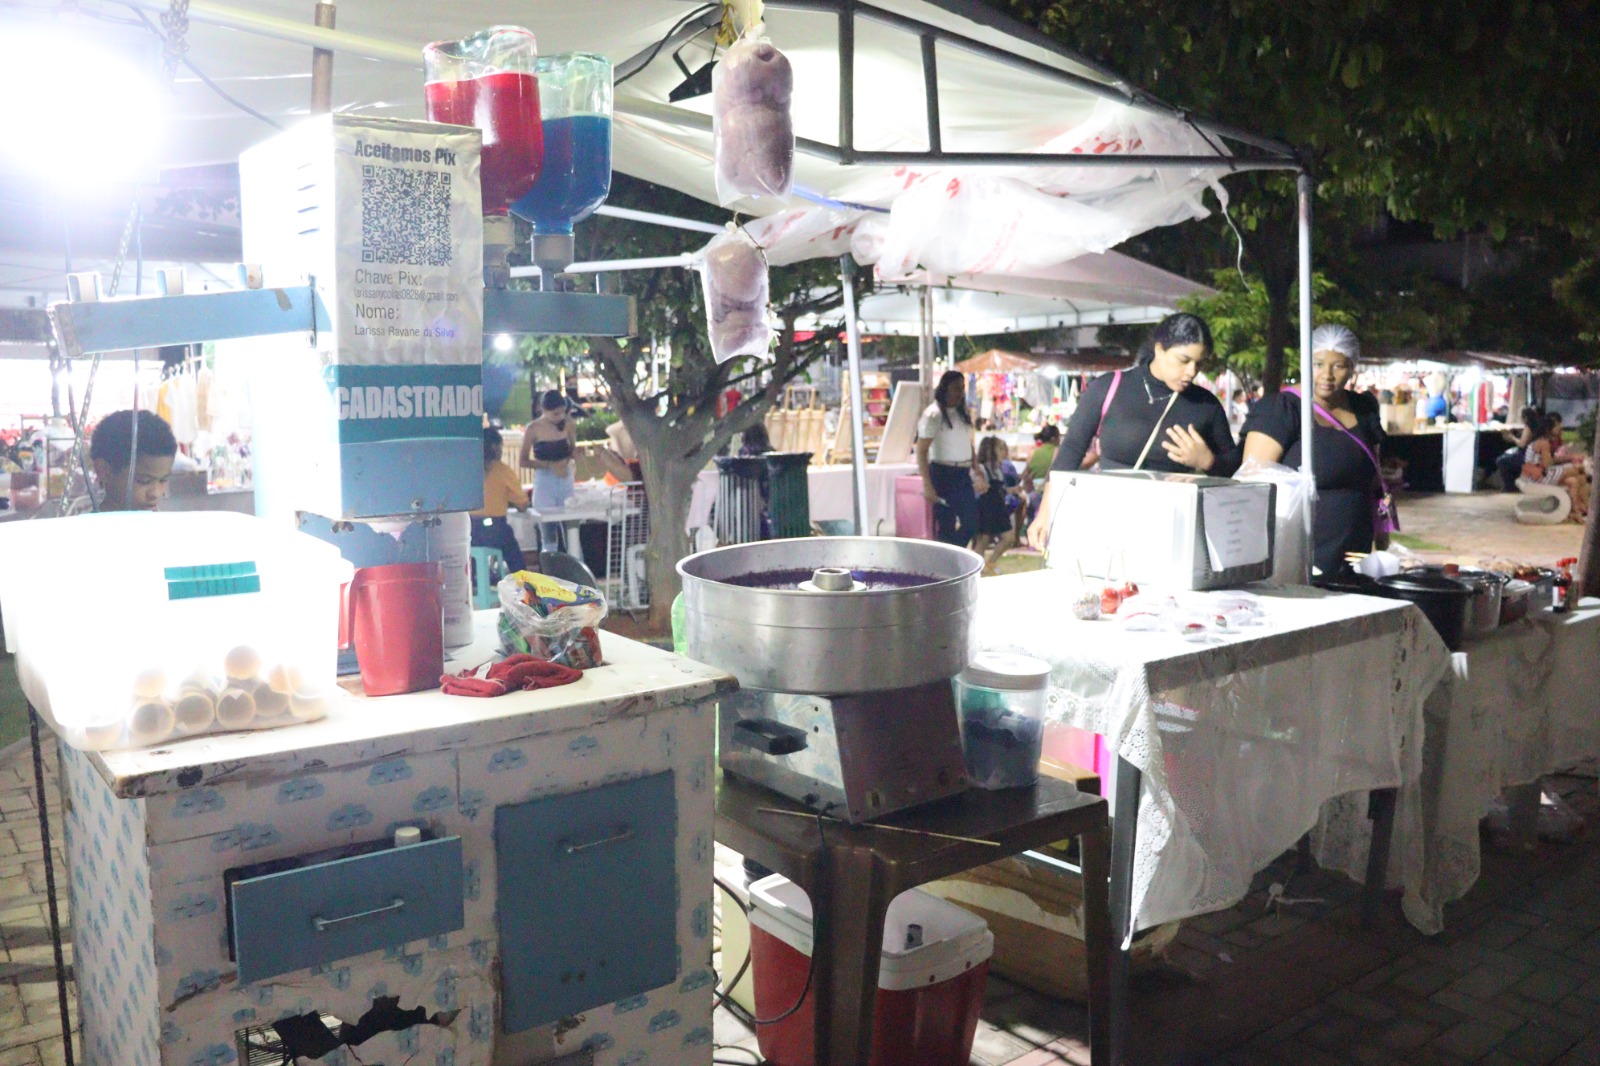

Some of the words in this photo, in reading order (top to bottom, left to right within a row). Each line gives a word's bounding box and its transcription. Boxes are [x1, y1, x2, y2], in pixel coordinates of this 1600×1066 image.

[355, 140, 431, 163] Aceitamos
[435, 147, 456, 166] Pix
[356, 268, 394, 285] Chave
[398, 270, 422, 286] Pix:
[356, 303, 399, 319] Nome:
[355, 325, 385, 336] Larissa
[389, 326, 420, 338] Rayane
[423, 328, 433, 337] da
[435, 327, 455, 338] Silva
[333, 385, 484, 420] CADASTRADO
